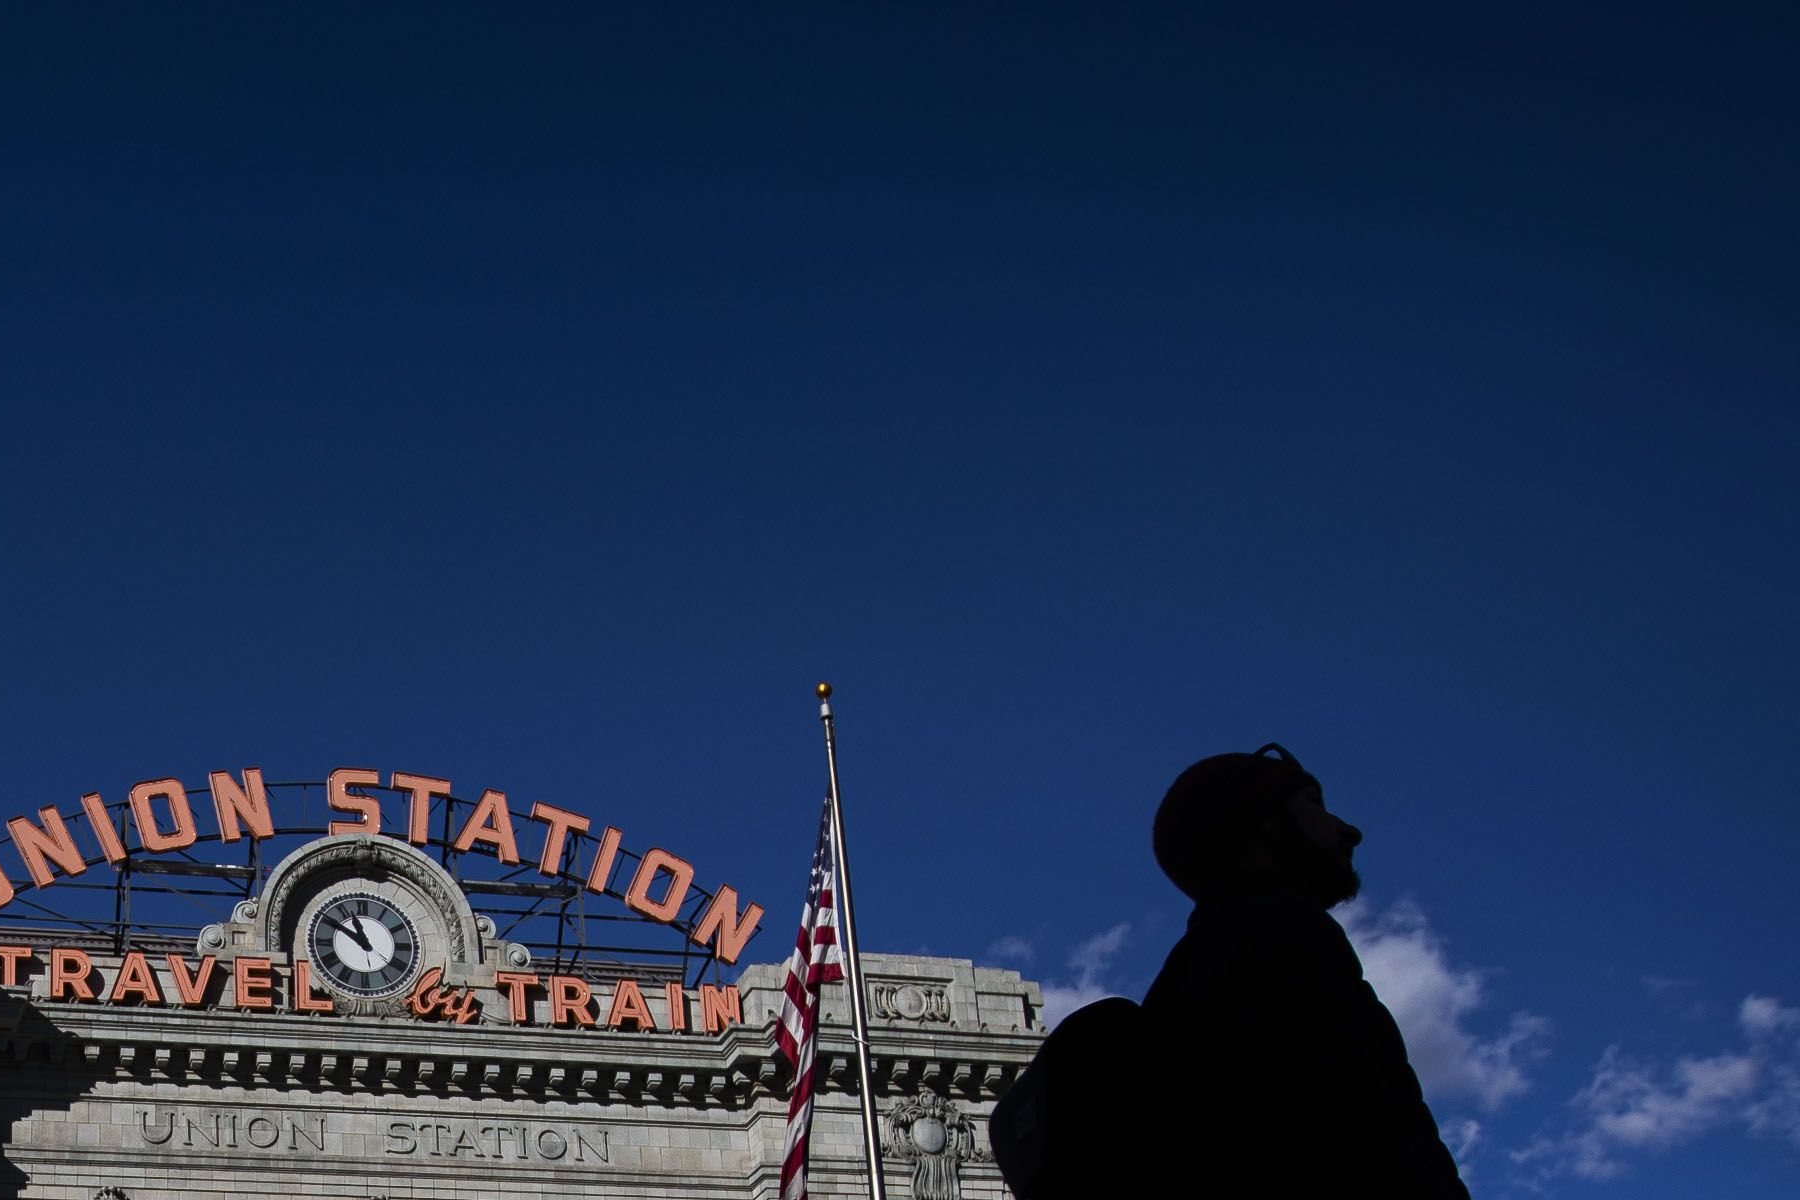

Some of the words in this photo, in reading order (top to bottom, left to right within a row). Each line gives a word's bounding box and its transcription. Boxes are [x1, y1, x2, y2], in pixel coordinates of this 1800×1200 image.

[327, 767, 765, 966] STATION
[402, 966, 479, 1025] by
[495, 971, 742, 1033] TRAIN
[136, 1111, 327, 1152] UNION
[386, 1122, 611, 1163] STATION
